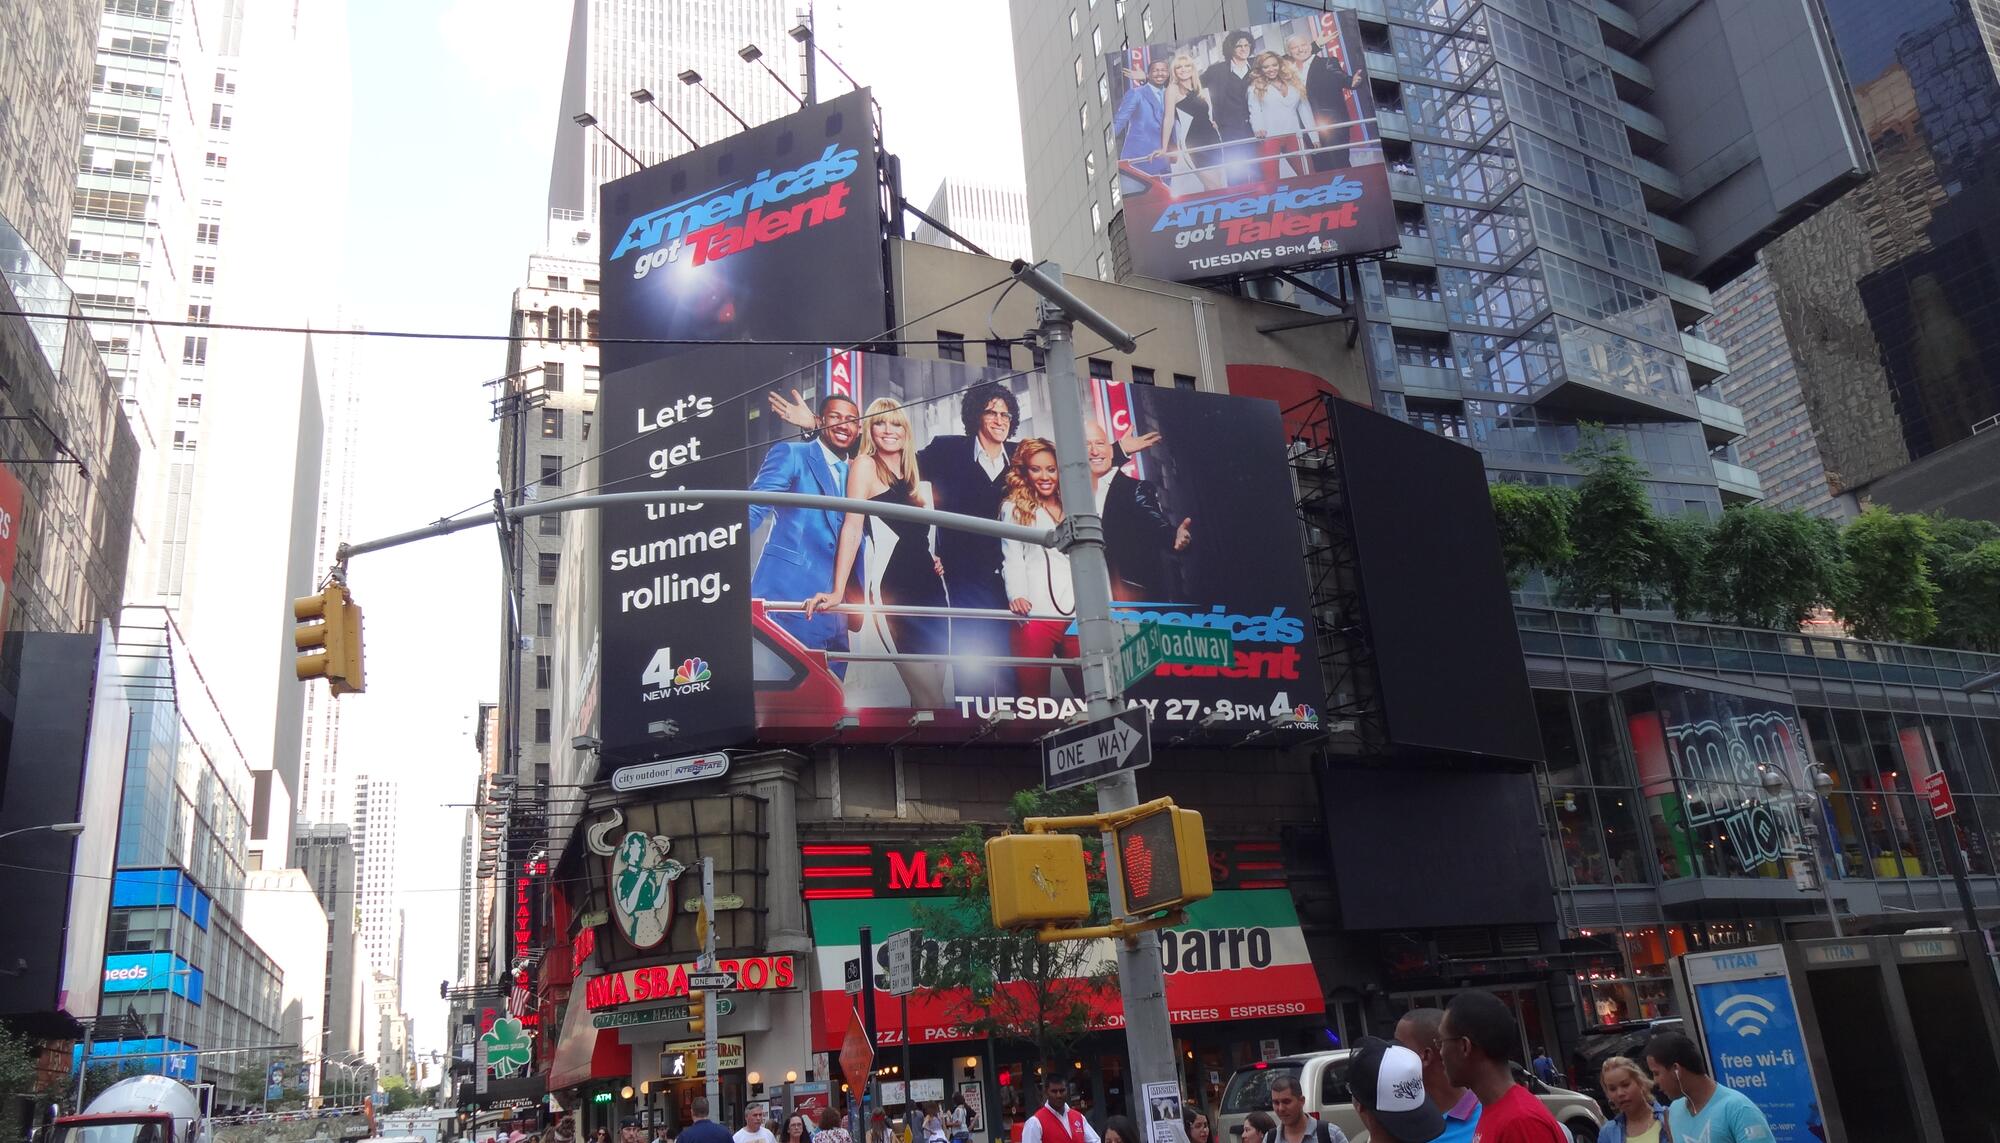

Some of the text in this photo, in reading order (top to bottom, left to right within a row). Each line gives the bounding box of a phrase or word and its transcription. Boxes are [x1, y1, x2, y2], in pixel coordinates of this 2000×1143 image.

[609, 143, 859, 261] America's
[1151, 175, 1363, 232] America's
[633, 181, 851, 279] got Talent
[1174, 202, 1359, 249] got Talent
[1307, 235, 1321, 251] 4
[1189, 245, 1305, 270] TUESDAYS 8PM
[637, 395, 714, 433] Let's
[648, 437, 701, 478] get
[610, 522, 742, 571] summer
[621, 572, 731, 613] rolling.
[1064, 601, 1304, 644] erica's
[1122, 646, 1134, 681] W
[1136, 636, 1149, 671] 49
[1155, 645, 1300, 680] ent
[1161, 629, 1229, 667] oadway
[642, 647, 674, 689] 4
[643, 680, 711, 702] NEW YORK
[955, 696, 1088, 720] TUESDAY
[1164, 699, 1201, 721] 27
[1269, 691, 1293, 717] 4
[1293, 722, 1320, 730] YORK
[674, 760, 723, 775] INTERSTATE
[1056, 729, 1131, 771] ONE WAY
[619, 768, 670, 784] city outdoor
[1160, 926, 1273, 976] barro
[1712, 953, 1758, 971] TITAN
[1822, 945, 1855, 960] TITAN
[1912, 940, 1944, 955] TITAN
[634, 956, 794, 1000] SBARO'S
[714, 977, 730, 985] WAY
[652, 1001, 728, 1020] MARKECE
[877, 1030, 910, 1044] ZZA
[1170, 1008, 1219, 1022] TREES
[1230, 1002, 1306, 1018] ESPRESSO
[1720, 1048, 1796, 1068] free wi-fi
[595, 1092, 612, 1102] ATM
[1725, 1072, 1767, 1088] here!
